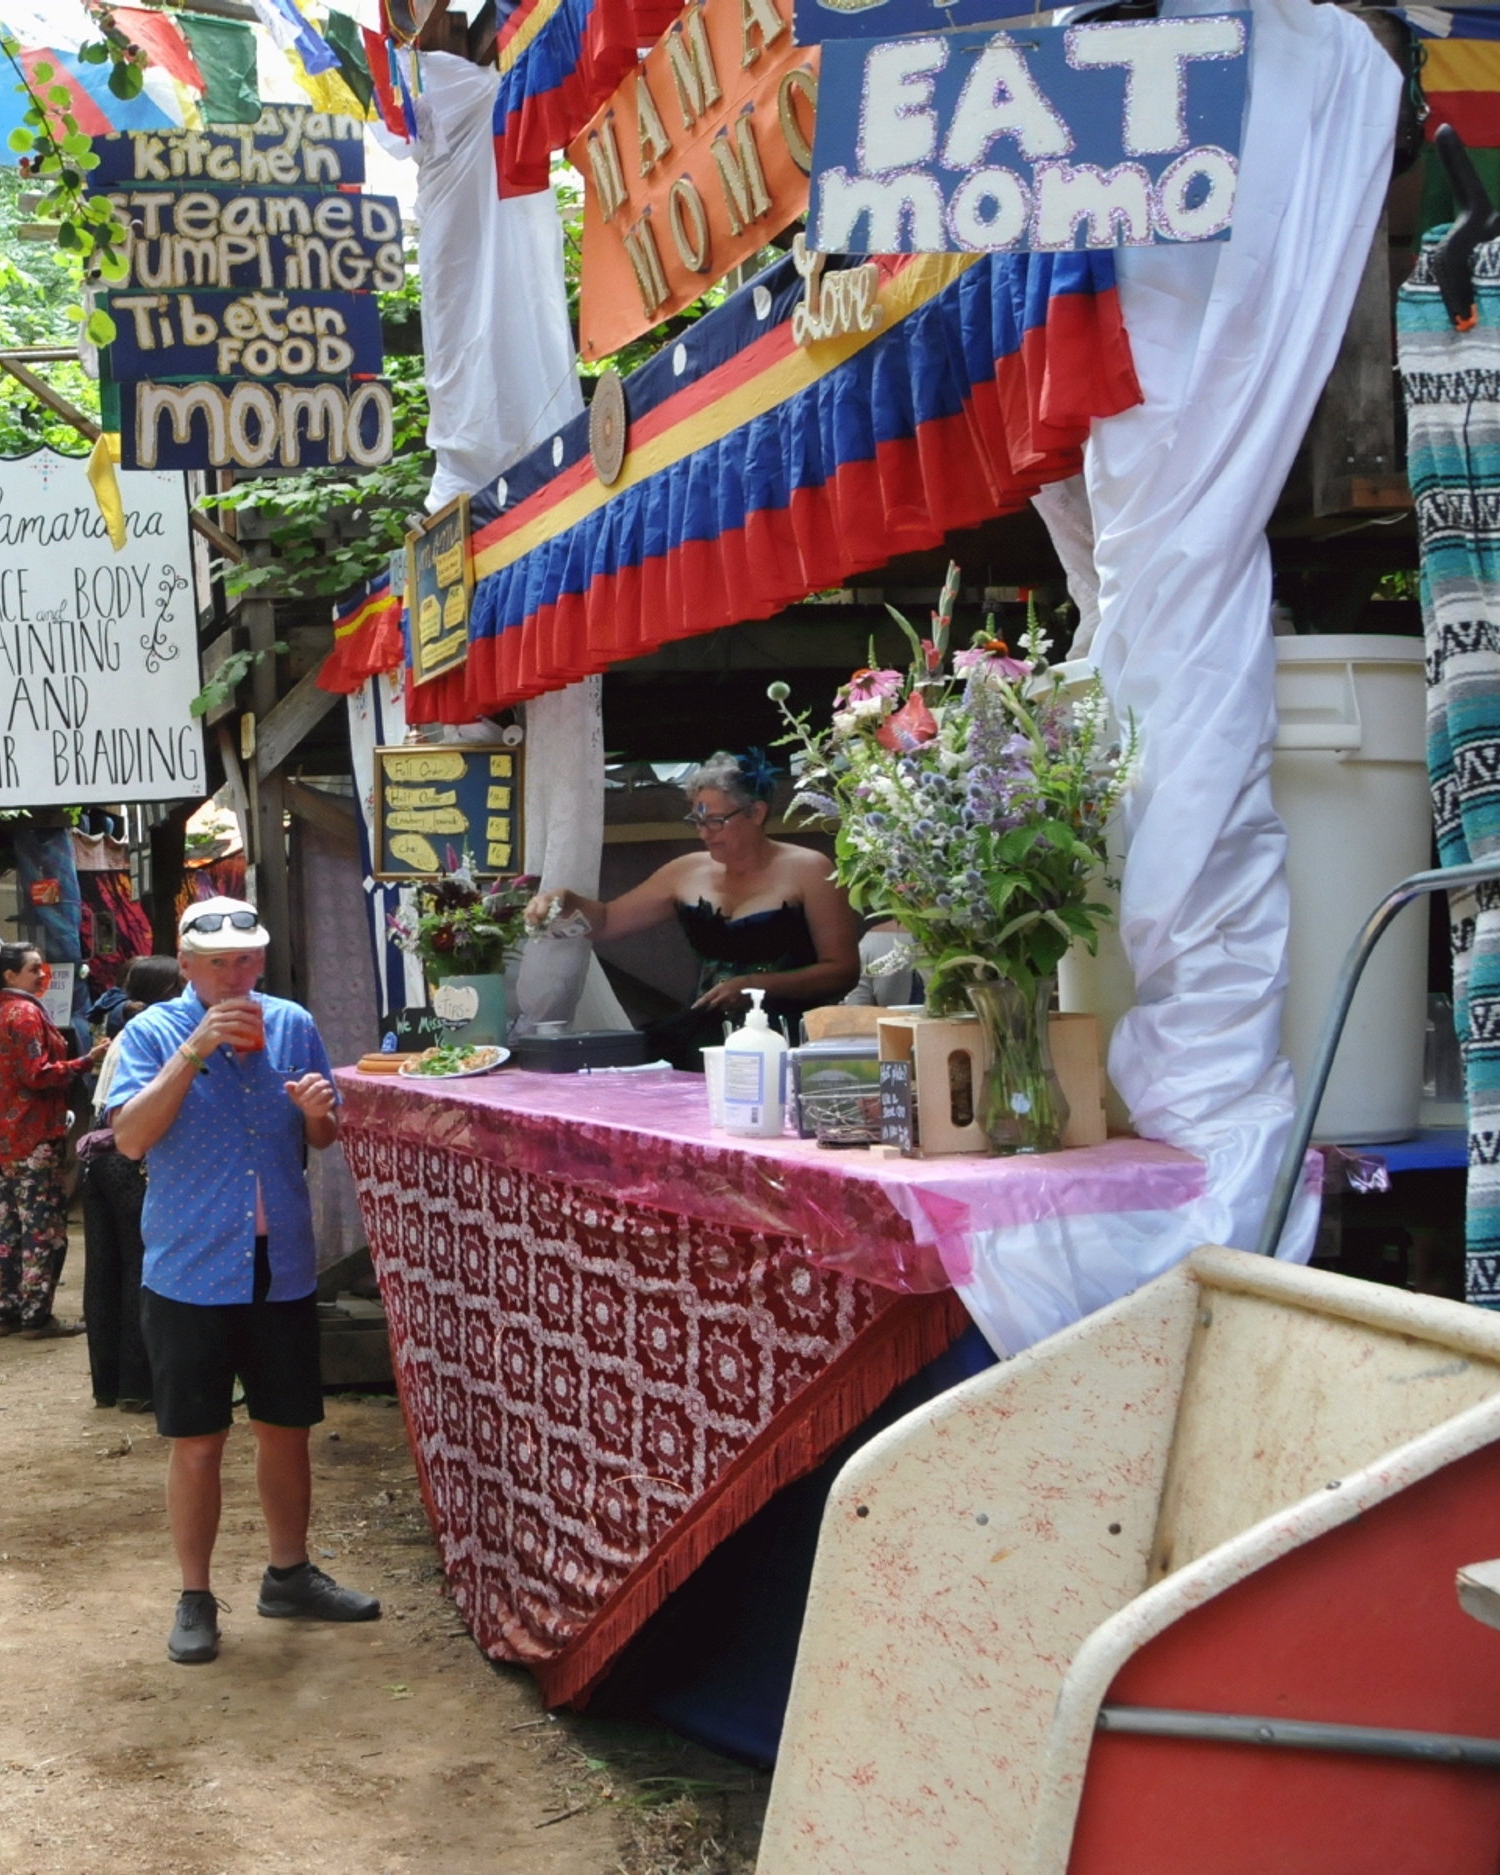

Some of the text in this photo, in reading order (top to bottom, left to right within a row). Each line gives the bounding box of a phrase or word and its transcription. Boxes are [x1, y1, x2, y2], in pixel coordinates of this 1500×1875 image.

[586, 0, 787, 224] MAMA
[858, 18, 1247, 175] EAT
[133, 131, 341, 184] Kitchen
[622, 67, 818, 320] MOMO
[812, 145, 1238, 253] momo
[792, 232, 883, 347] Love
[112, 292, 345, 349] Tibetan
[217, 336, 354, 375] FOOD
[35, 600, 68, 623] and
[74, 563, 151, 620] BODY
[7, 676, 89, 731] AND
[52, 725, 200, 787] BRAIDING
[395, 760, 443, 777] Full Order
[390, 790, 411, 804] Half
